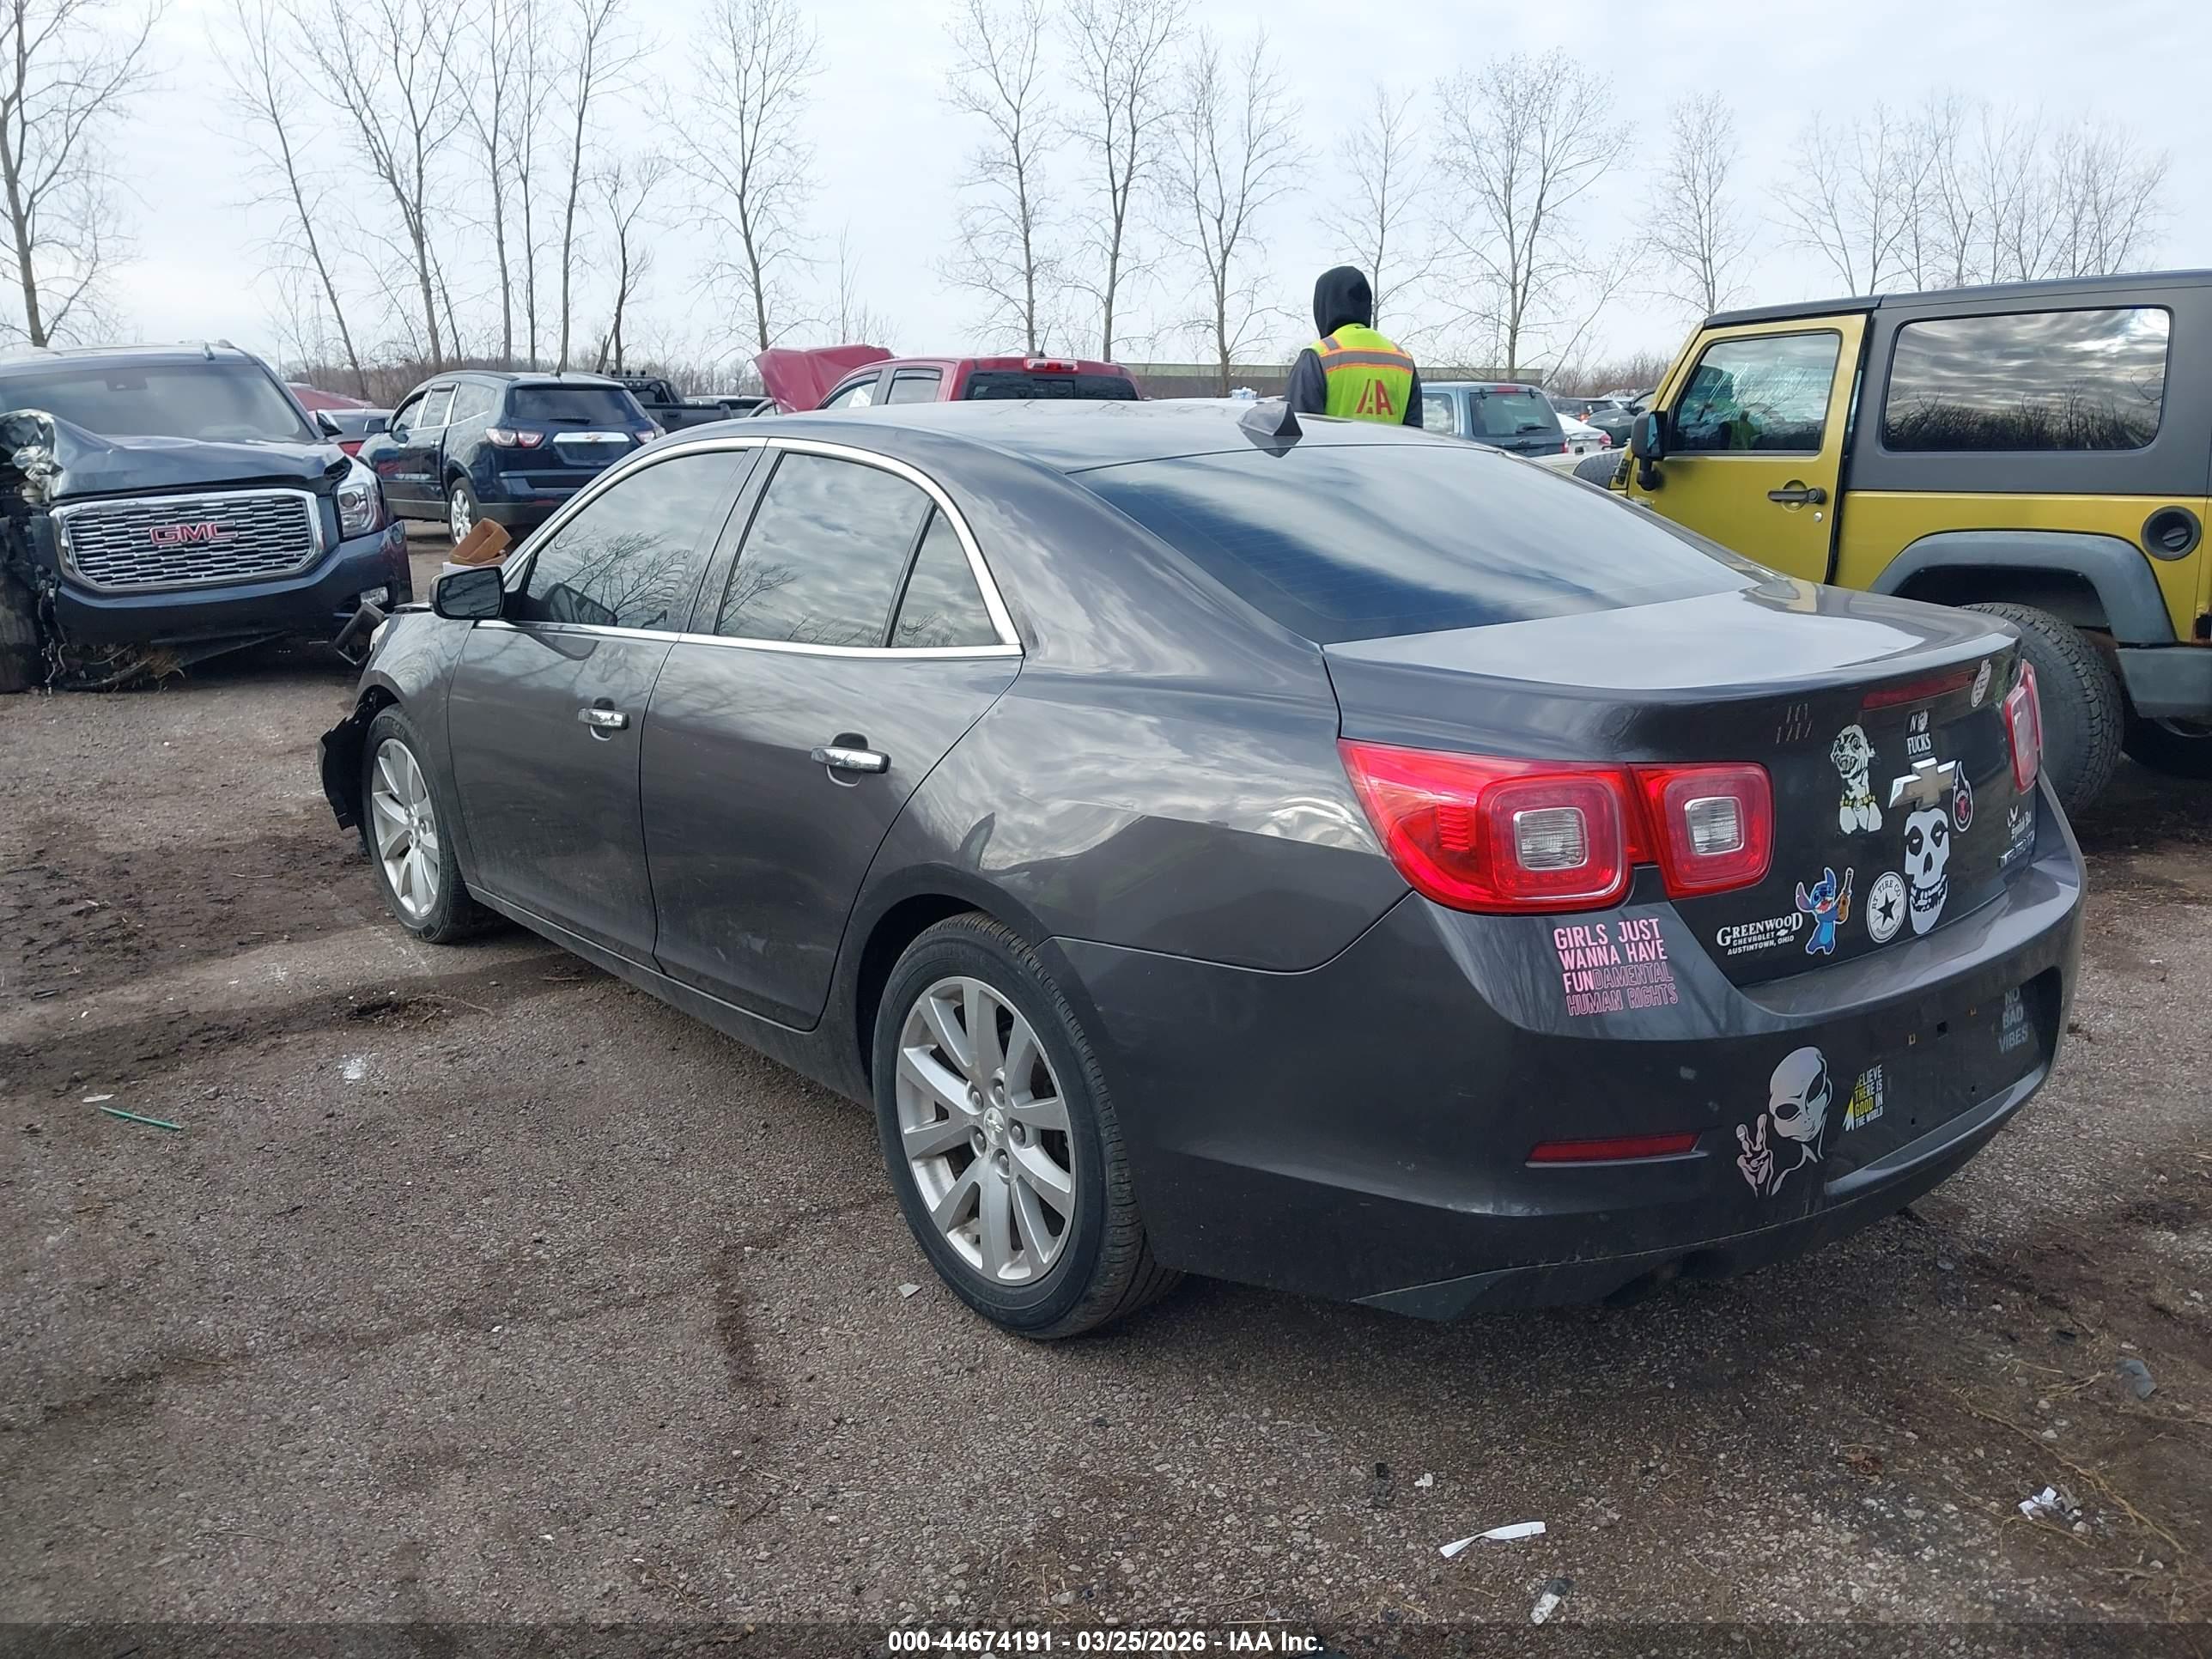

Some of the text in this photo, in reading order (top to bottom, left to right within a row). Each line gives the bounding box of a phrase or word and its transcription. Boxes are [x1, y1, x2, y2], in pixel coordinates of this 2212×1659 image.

[149, 520, 239, 545] GMC
[1906, 732, 1931, 756] FUCKS
[1877, 879, 1893, 894] TIRE
[1553, 918, 1661, 950] GIRLS JUST
[1717, 912, 1803, 946] GREENWOOD
[1733, 931, 1776, 946] CHEVROLET
[1778, 934, 1795, 945] OHIO
[1558, 939, 1668, 970] WANNA HAVE
[1563, 961, 1674, 994] FUNDAMENTAL
[1566, 982, 1679, 1017] HUMAN RIGHTS
[2005, 988, 2020, 1006] NO
[2002, 1003, 2023, 1030] BAD
[1998, 1024, 2028, 1053] VIBES
[1855, 1079, 1882, 1102] THERE IS
[1855, 1091, 1883, 1117] GOOD IN
[1855, 1115, 1865, 1128] THE
